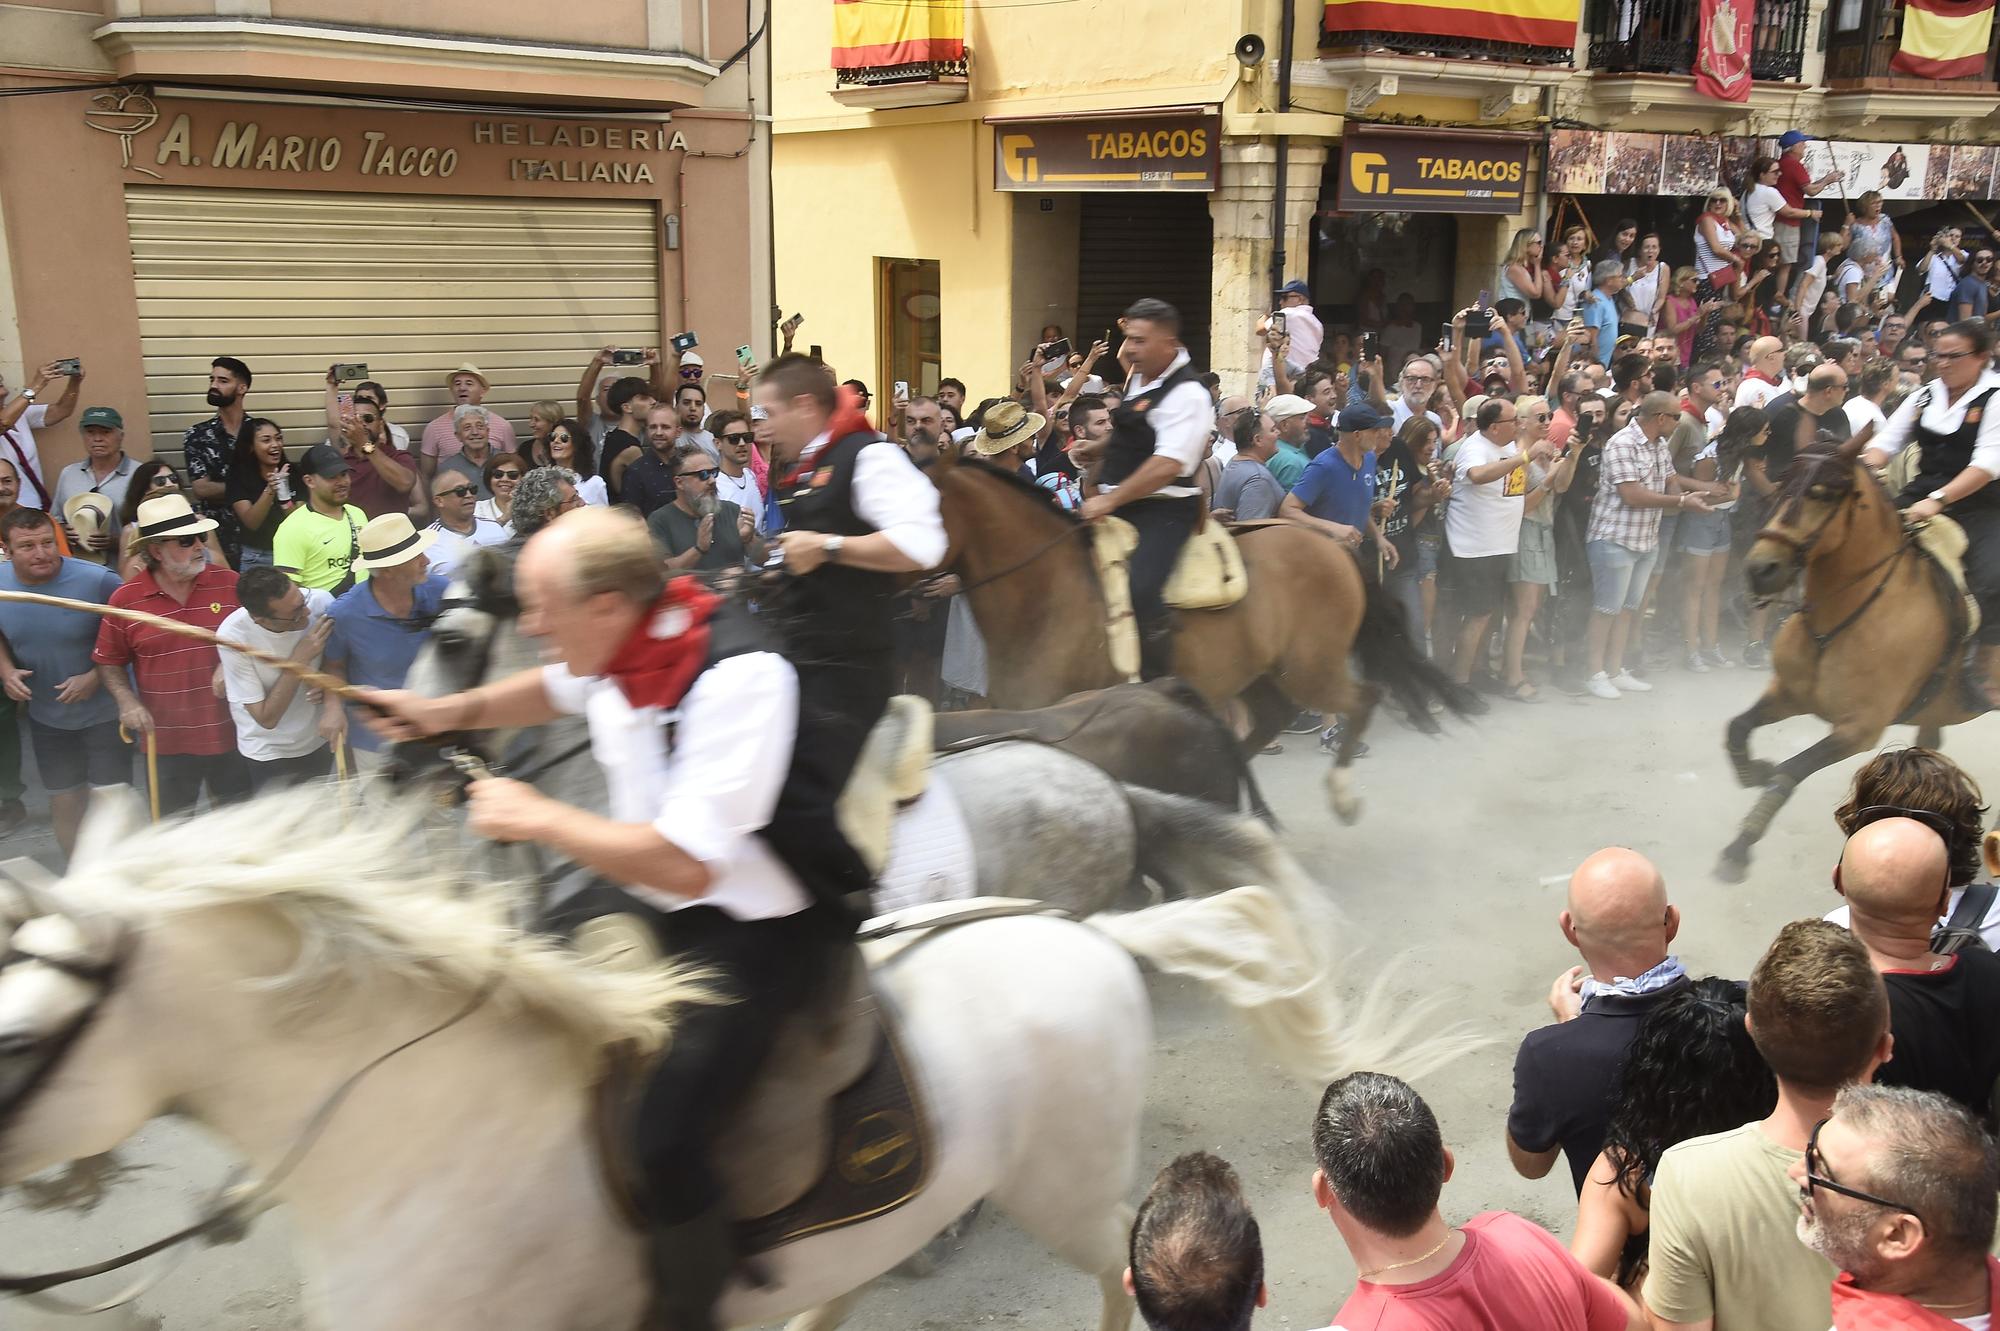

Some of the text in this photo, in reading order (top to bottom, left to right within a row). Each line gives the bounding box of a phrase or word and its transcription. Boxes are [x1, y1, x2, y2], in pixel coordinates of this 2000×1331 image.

[156, 113, 458, 177] A. MARIO TACCO
[473, 121, 690, 151] HELADERIA
[1087, 128, 1208, 160] TABACOS
[510, 158, 655, 184] ITALIANA
[1417, 157, 1522, 182] TABACOS
